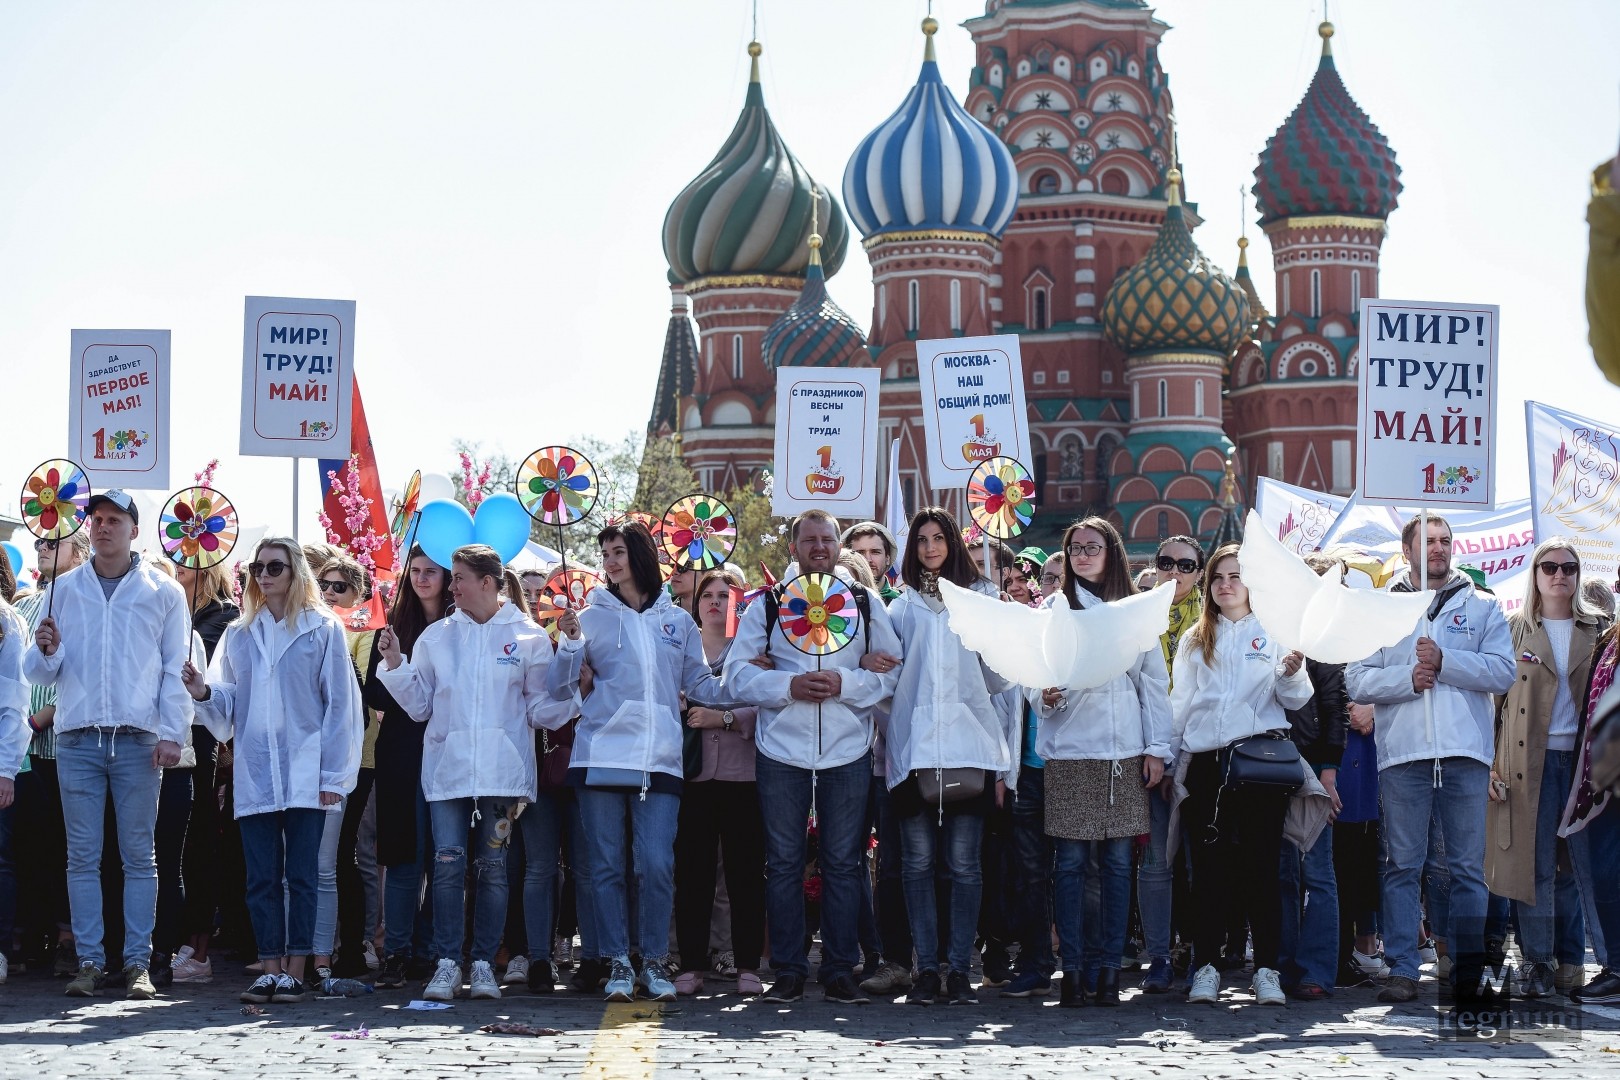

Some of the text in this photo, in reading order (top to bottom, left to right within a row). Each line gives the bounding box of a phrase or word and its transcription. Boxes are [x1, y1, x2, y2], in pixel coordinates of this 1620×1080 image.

[270, 326, 328, 346] МИР!
[1376, 312, 1484, 347] МИР!
[88, 359, 141, 378] ЗДРАВСТВУЕТ
[108, 354, 119, 364] ДА
[262, 353, 333, 375] ТРУД!
[943, 354, 991, 369] МОСКВА
[86, 371, 150, 398] ПЕРВОЕ
[957, 374, 984, 388] НАШ
[1369, 357, 1484, 400] ТРУД!
[269, 378, 328, 402] МАЙ!
[792, 389, 864, 398] С ПРАЗДНИКОМ
[102, 394, 142, 416] МАЯ!
[810, 402, 844, 410] ВЕСНЫ
[938, 393, 1011, 410] ОБЩИЙ ДОМ!
[299, 420, 308, 437] 1
[822, 415, 830, 423] И
[969, 413, 985, 437] 1
[1373, 406, 1482, 446] МАЙ!
[808, 427, 841, 436] ТРУДА!
[92, 427, 106, 459] 1
[968, 447, 993, 458] МАЯ
[106, 451, 127, 460] МАЯ
[816, 445, 832, 470] 1
[811, 479, 835, 489] МАЯ
[1421, 463, 1436, 493] 1
[1435, 486, 1457, 495] МАЯ
[1451, 530, 1535, 555] ЛЬШАЯ
